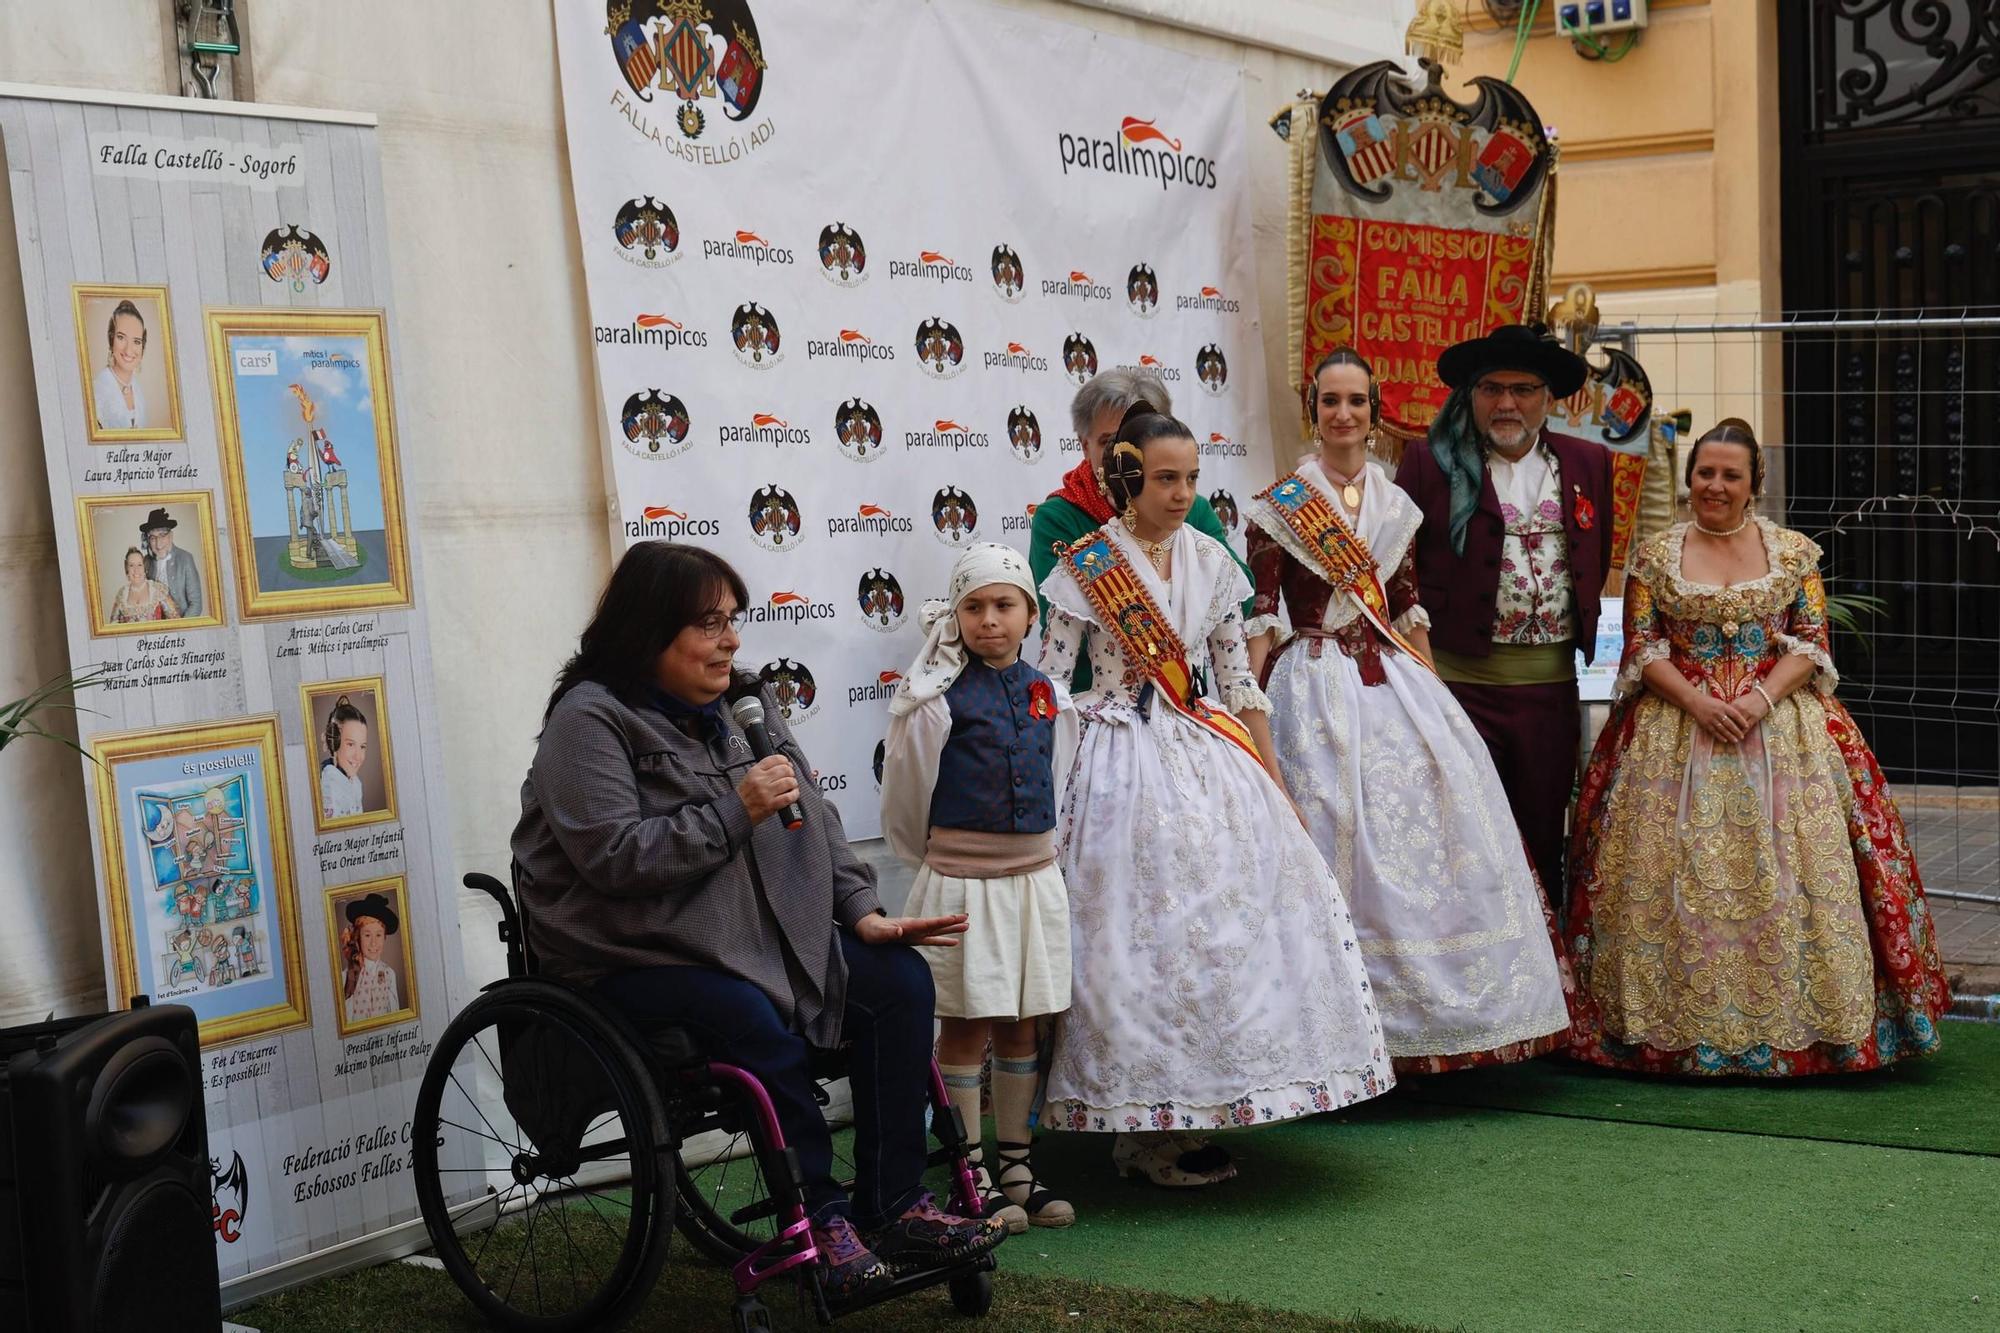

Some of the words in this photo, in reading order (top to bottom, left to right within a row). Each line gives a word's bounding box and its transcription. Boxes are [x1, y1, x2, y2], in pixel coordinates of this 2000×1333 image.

[610, 89, 661, 147] FALLA
[665, 136, 741, 165] CASTELLÓ
[741, 138, 749, 154] I
[750, 117, 776, 150] ADJ
[100, 144, 148, 166] Falla
[155, 148, 223, 170] Castelló
[240, 155, 296, 179] Sogorb
[1059, 130, 1217, 191] paralimpicos
[703, 237, 794, 267] paralimpicos
[889, 258, 973, 284] paralimpicos
[1042, 277, 1112, 303] paralimpicos
[1378, 266, 1469, 306] FALLA
[595, 322, 708, 350] paralimpicos
[1361, 312, 1480, 346] CASTELLÓ
[807, 336, 895, 363] paralimpicos
[984, 349, 1048, 374] paralimpicos
[719, 421, 811, 448] paralimpicos
[905, 428, 989, 452] paralimpicos
[106, 448, 139, 463] Fallera
[142, 449, 173, 466] Major
[84, 469, 112, 482] Laura
[113, 467, 155, 485] Aparicio
[157, 463, 198, 479] Terrádez
[827, 515, 913, 538] paralimpicos
[136, 635, 187, 652] Presidents
[288, 626, 322, 641] Artista:
[324, 621, 350, 637] Carlos
[352, 620, 374, 634] Carsí
[100, 660, 123, 675] Juan
[126, 653, 155, 672] Carlos
[157, 653, 179, 668] Saíz
[181, 650, 225, 666] Hinarejos
[276, 645, 302, 658] Lema:
[103, 676, 139, 691] Mariam
[141, 670, 191, 688] Sanmartín
[192, 667, 227, 681] Vicente
[183, 759, 195, 774] és
[198, 753, 256, 776] possible!!!
[312, 840, 342, 856] Fallera
[344, 836, 370, 852] Major
[371, 828, 404, 849] Infantil
[320, 860, 337, 872] Eva
[340, 853, 365, 868] Orient
[368, 847, 399, 864] Tamarit
[346, 1037, 383, 1056] President
[386, 1025, 418, 1048] Infantil
[211, 1056, 227, 1069] Fet
[334, 1060, 368, 1076] Máximo
[369, 1049, 407, 1067] Delmonte
[409, 1040, 432, 1057] Palop
[211, 1074, 223, 1088] Es
[225, 1062, 271, 1089] possible!!!
[283, 1138, 351, 1176] Federació
[355, 1125, 397, 1155] Falles
[294, 1171, 357, 1204] Esbossos
[361, 1153, 402, 1183] Falles
